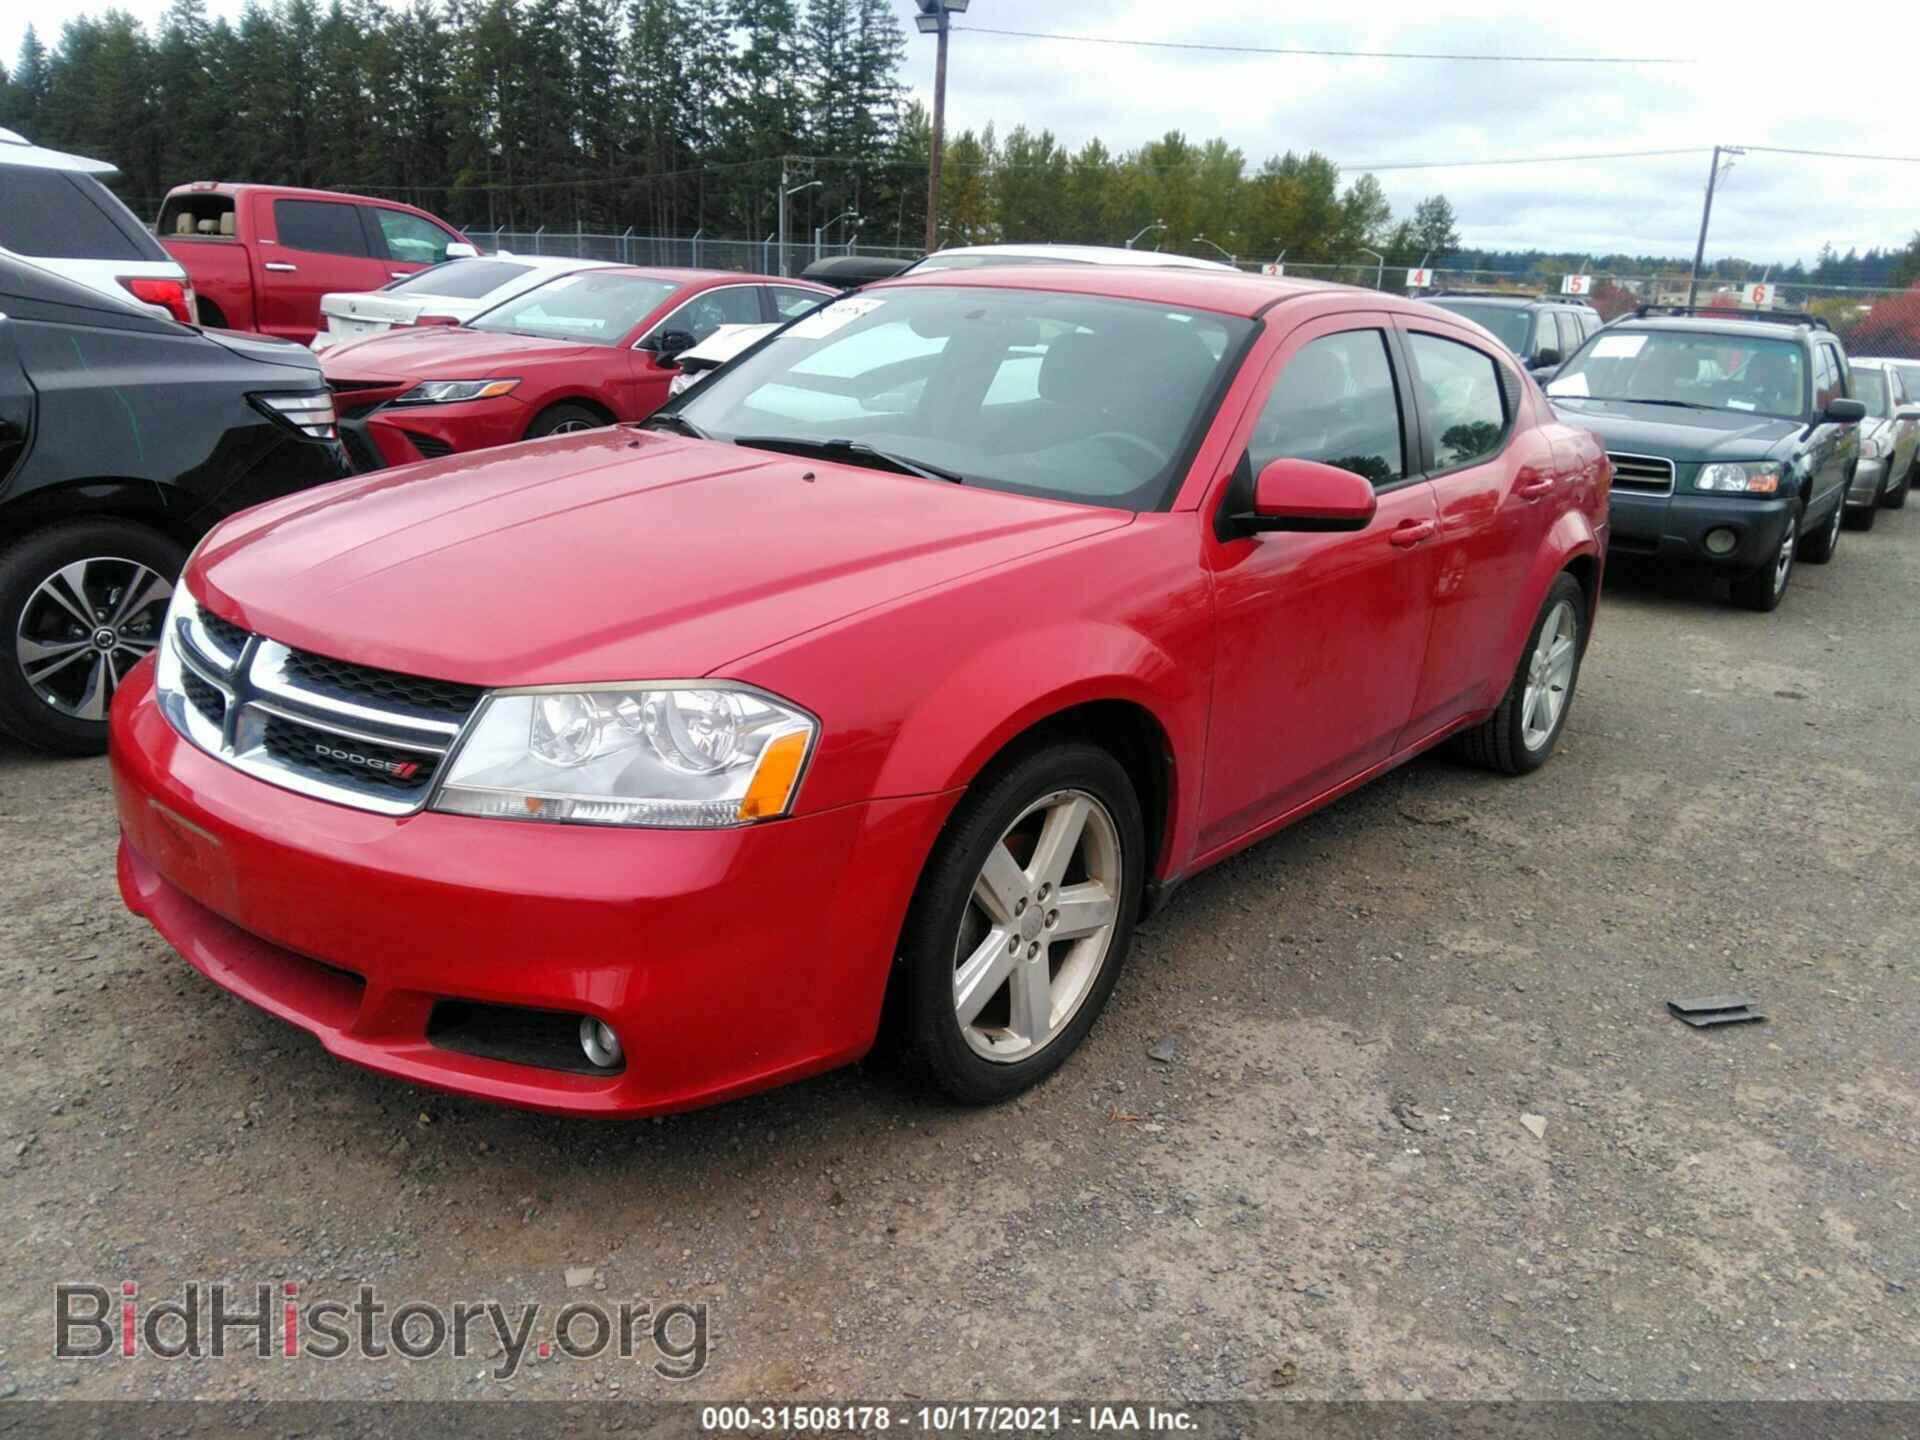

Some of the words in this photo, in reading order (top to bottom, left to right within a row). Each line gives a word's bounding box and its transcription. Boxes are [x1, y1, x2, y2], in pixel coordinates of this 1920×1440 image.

[1414, 269, 1424, 287] 4
[1571, 274, 1582, 293] 5
[1752, 284, 1765, 304] 6
[315, 744, 402, 772] DODGE
